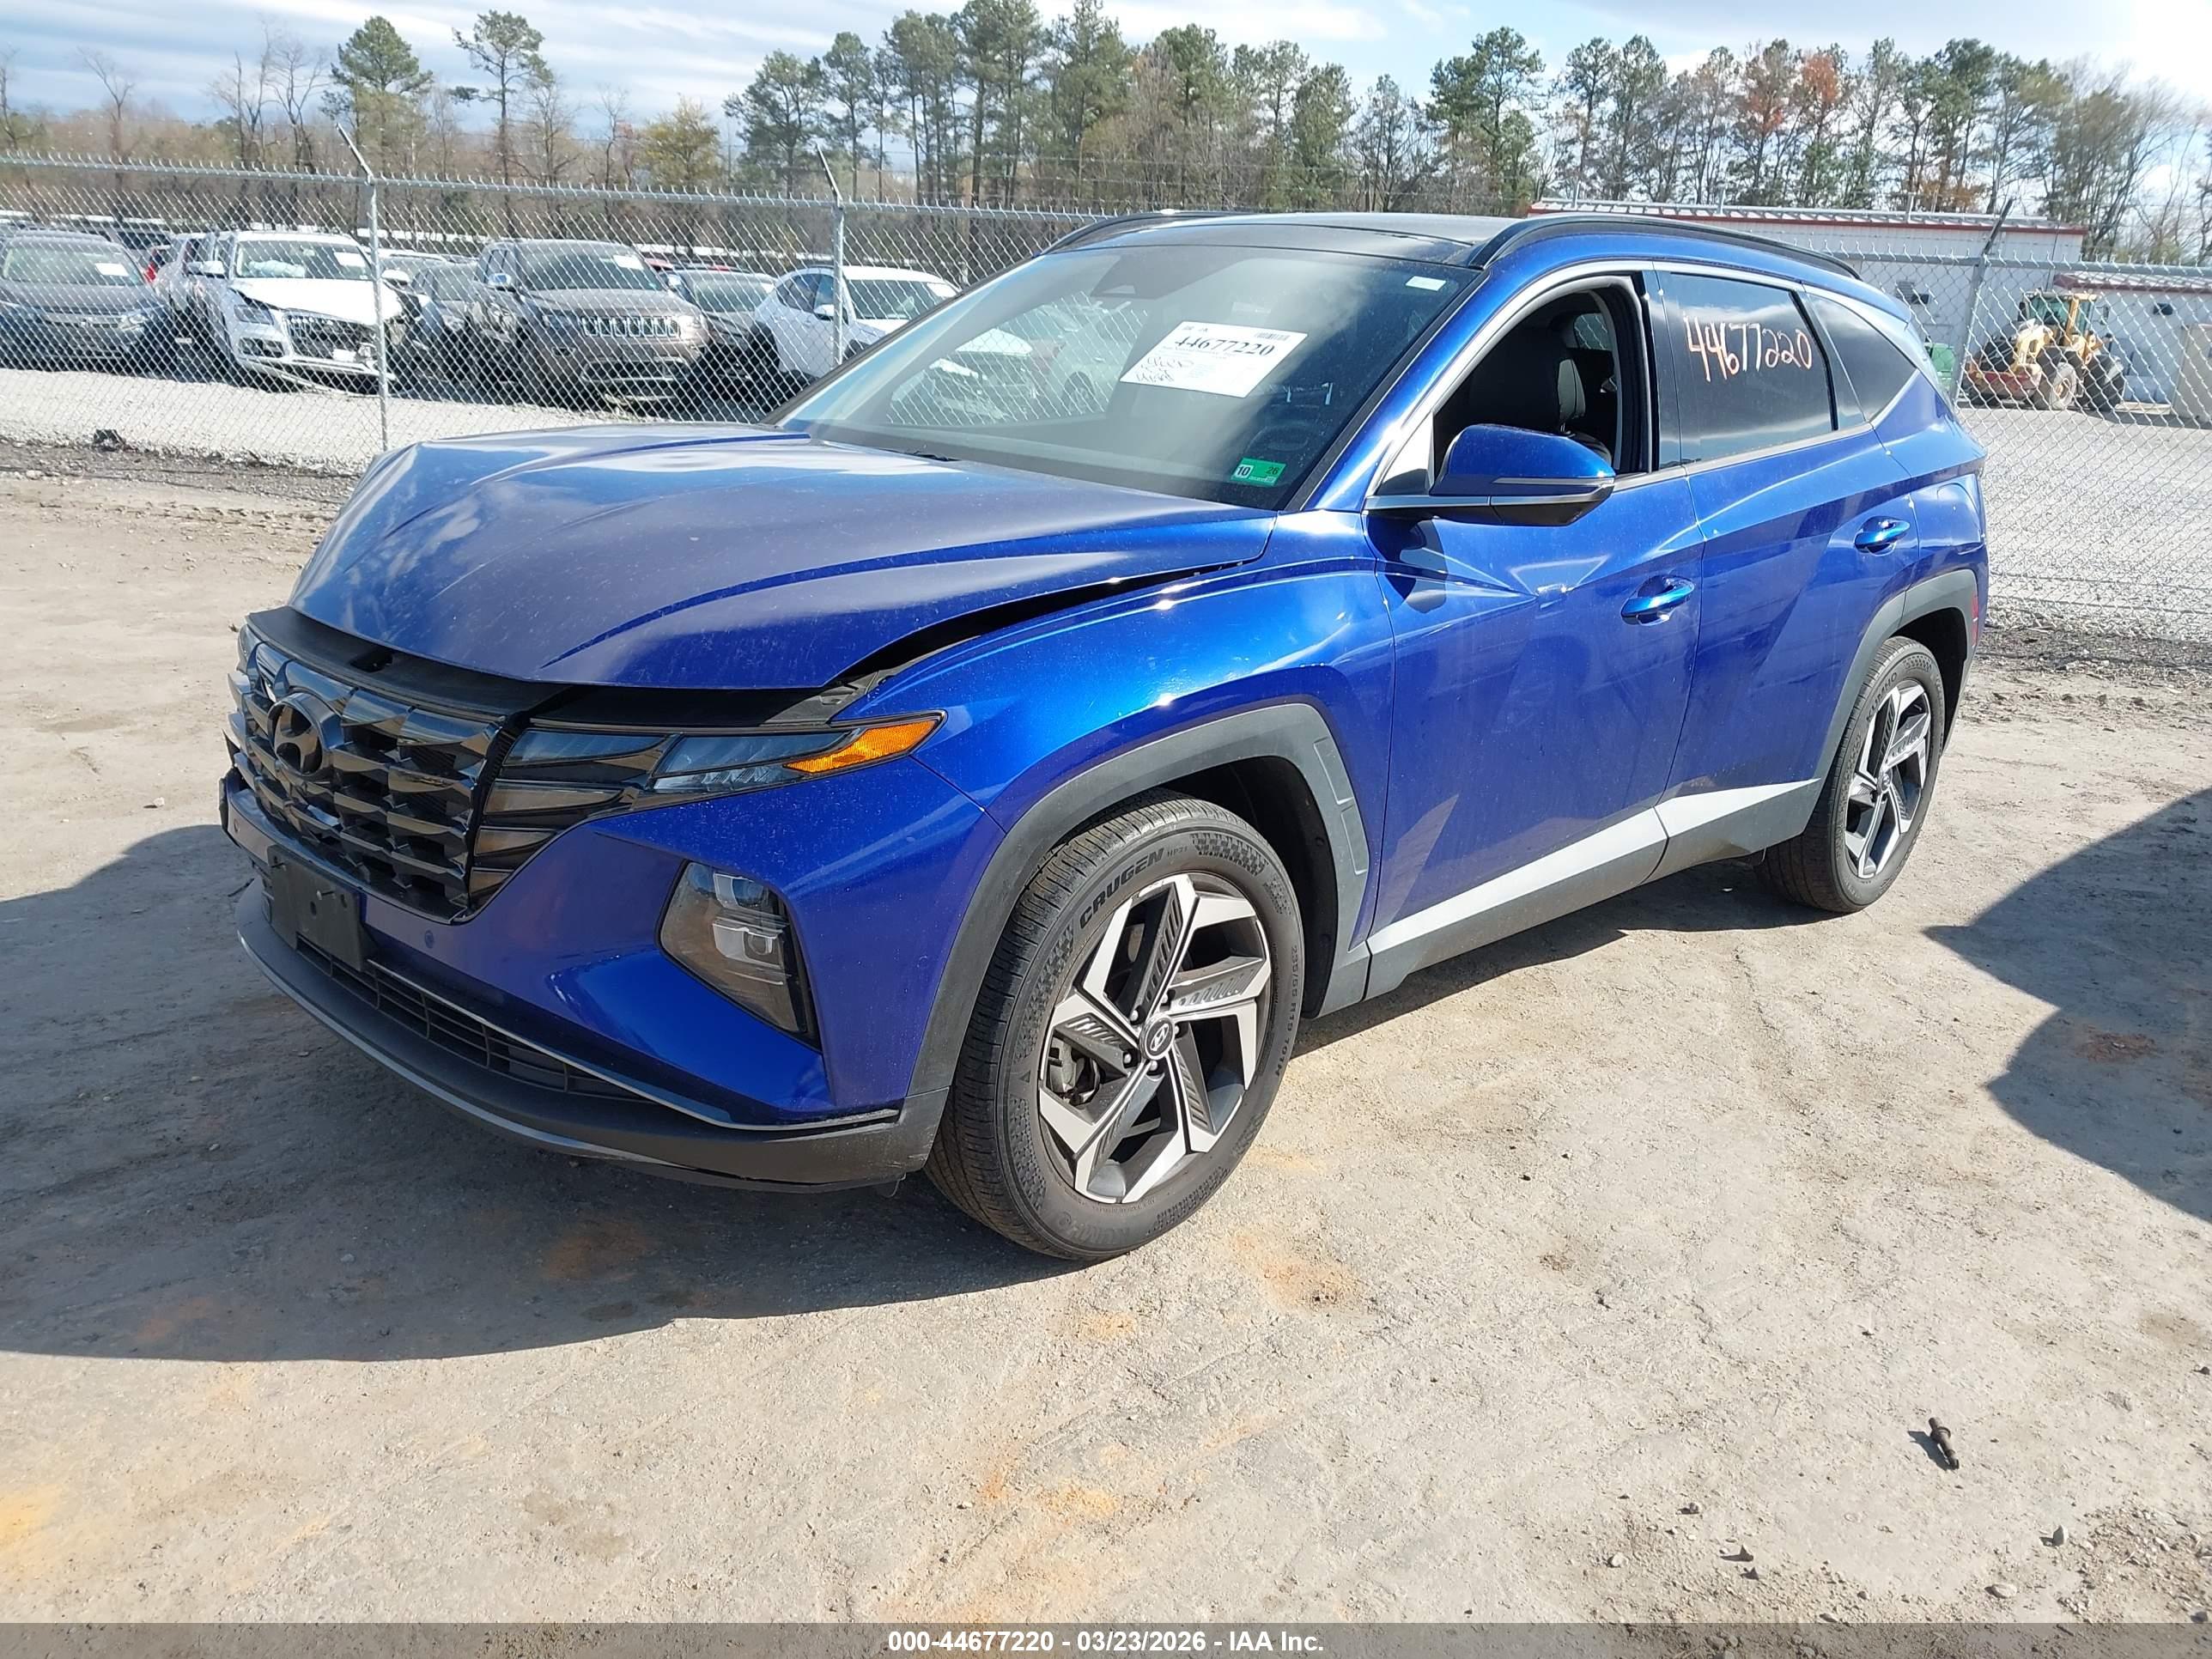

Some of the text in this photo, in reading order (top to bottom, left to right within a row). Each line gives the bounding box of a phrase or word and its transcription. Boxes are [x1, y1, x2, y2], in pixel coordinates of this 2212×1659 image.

[1174, 336, 1276, 356] 44677220
[1684, 314, 1813, 382] 44677220
[1237, 465, 1279, 477] 10 26
[1079, 848, 1165, 928] CRUGEN
